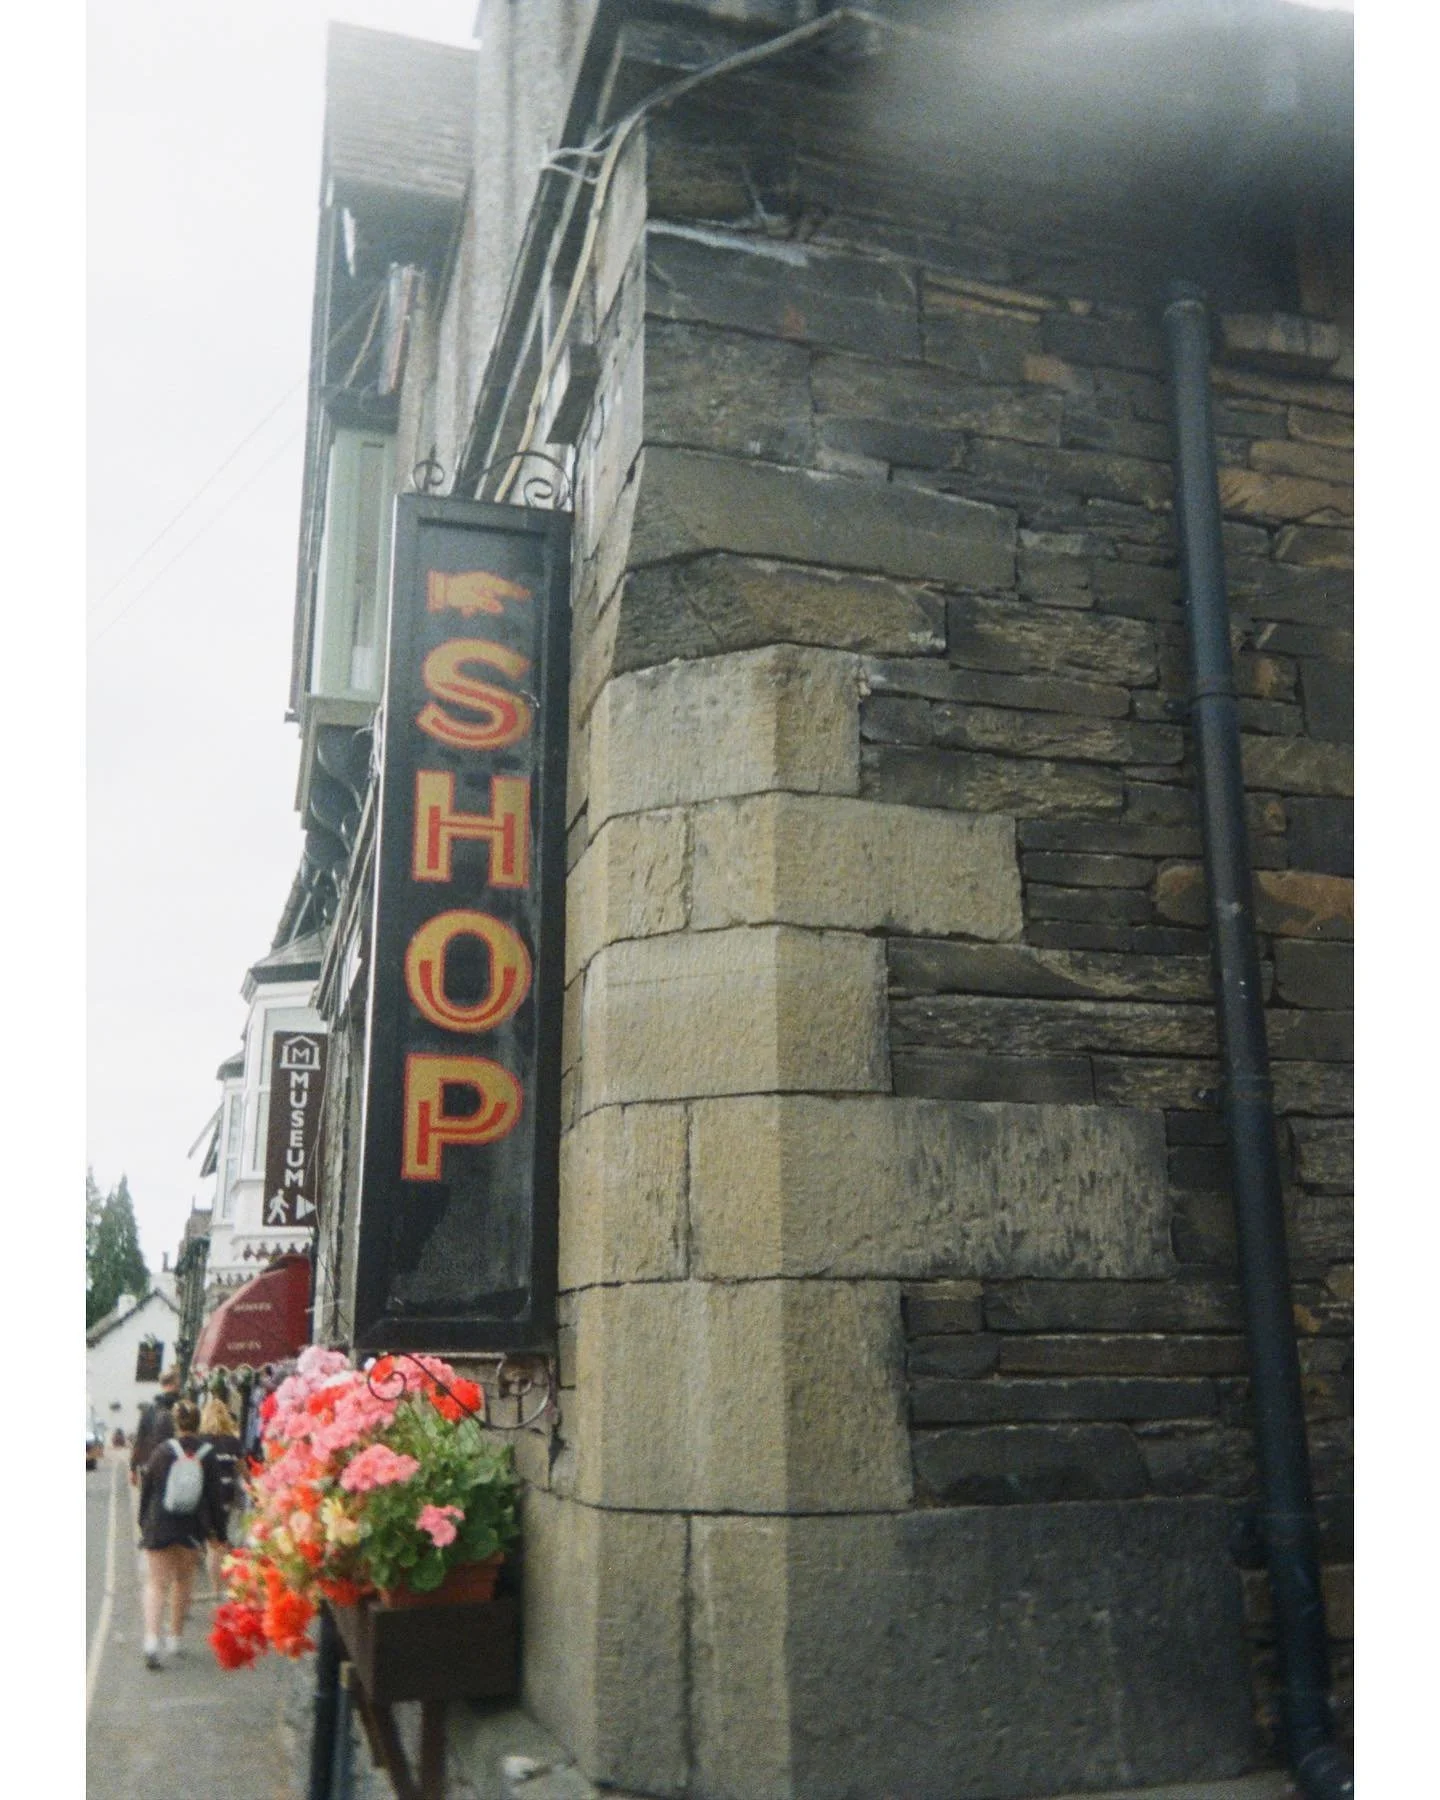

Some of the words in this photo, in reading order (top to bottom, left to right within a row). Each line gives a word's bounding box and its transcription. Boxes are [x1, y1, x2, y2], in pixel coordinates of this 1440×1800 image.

[402, 638, 532, 1181] SHOP
[292, 1047, 310, 1063] M
[284, 1071, 309, 1187] MUSEUM
